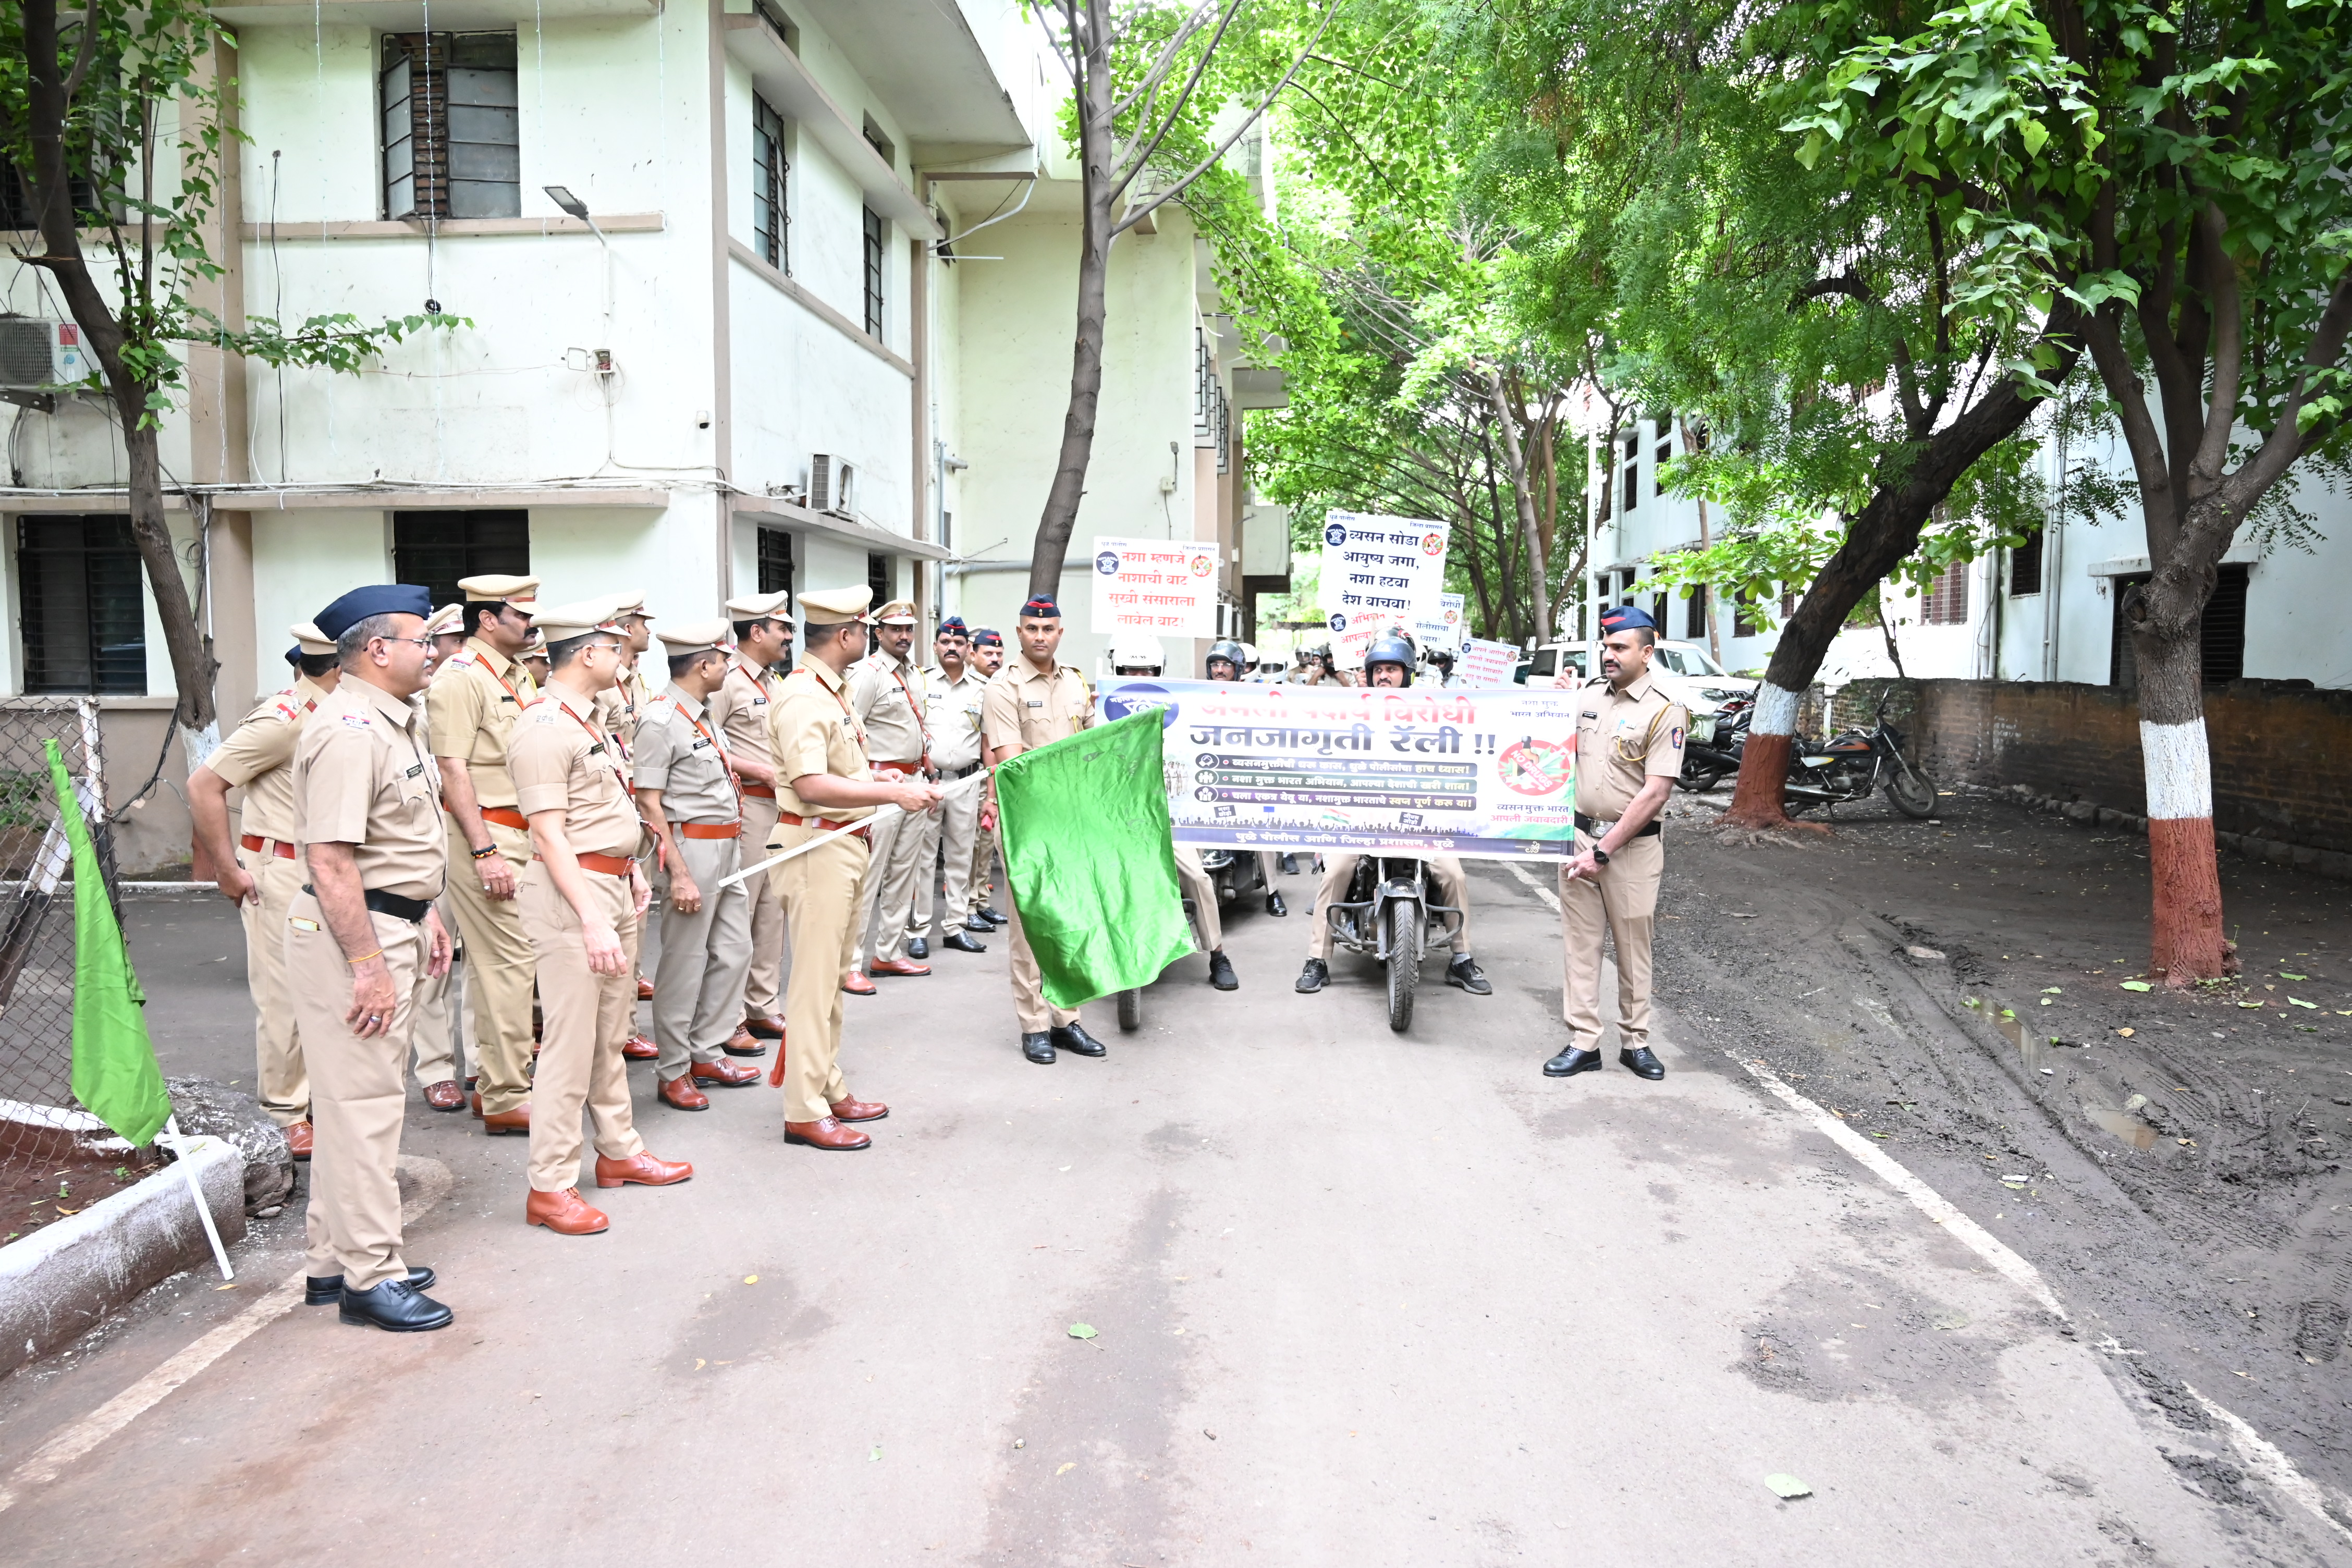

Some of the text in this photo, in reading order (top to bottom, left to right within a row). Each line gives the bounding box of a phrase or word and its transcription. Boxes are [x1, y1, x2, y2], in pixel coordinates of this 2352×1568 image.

[1350, 530, 1385, 543] व्यसन
[1389, 531, 1419, 546] सोडा
[1122, 550, 1185, 564] नशा म्हणजे
[1343, 552, 1419, 570] आयुष्य जगा,
[1118, 569, 1187, 585] नाशाची वाट
[1350, 573, 1409, 588] नशा हटवा
[1109, 590, 1195, 607] सुखी संसाराला
[1342, 590, 1411, 610] देश वाचवा!
[1117, 611, 1154, 625] लावेल
[1383, 695, 1477, 724] विरोधी
[1190, 723, 1375, 755] जनजागृती
[1389, 725, 1463, 754] रॅली
[1511, 750, 1553, 789] NO DRUGS
[1255, 776, 1276, 786] मुक्त
[1254, 793, 1278, 801] एकत्र
[1353, 794, 1387, 804] भारताचे
[1414, 796, 1431, 808] पूर्ण
[1490, 813, 1521, 822] आपली
[1235, 831, 1257, 843] धुळे
[1259, 831, 1300, 842] पोलीस
[1304, 834, 1337, 843] आणि
[1340, 835, 1376, 846] जिल्हा
[1432, 838, 1454, 850] धुळे
